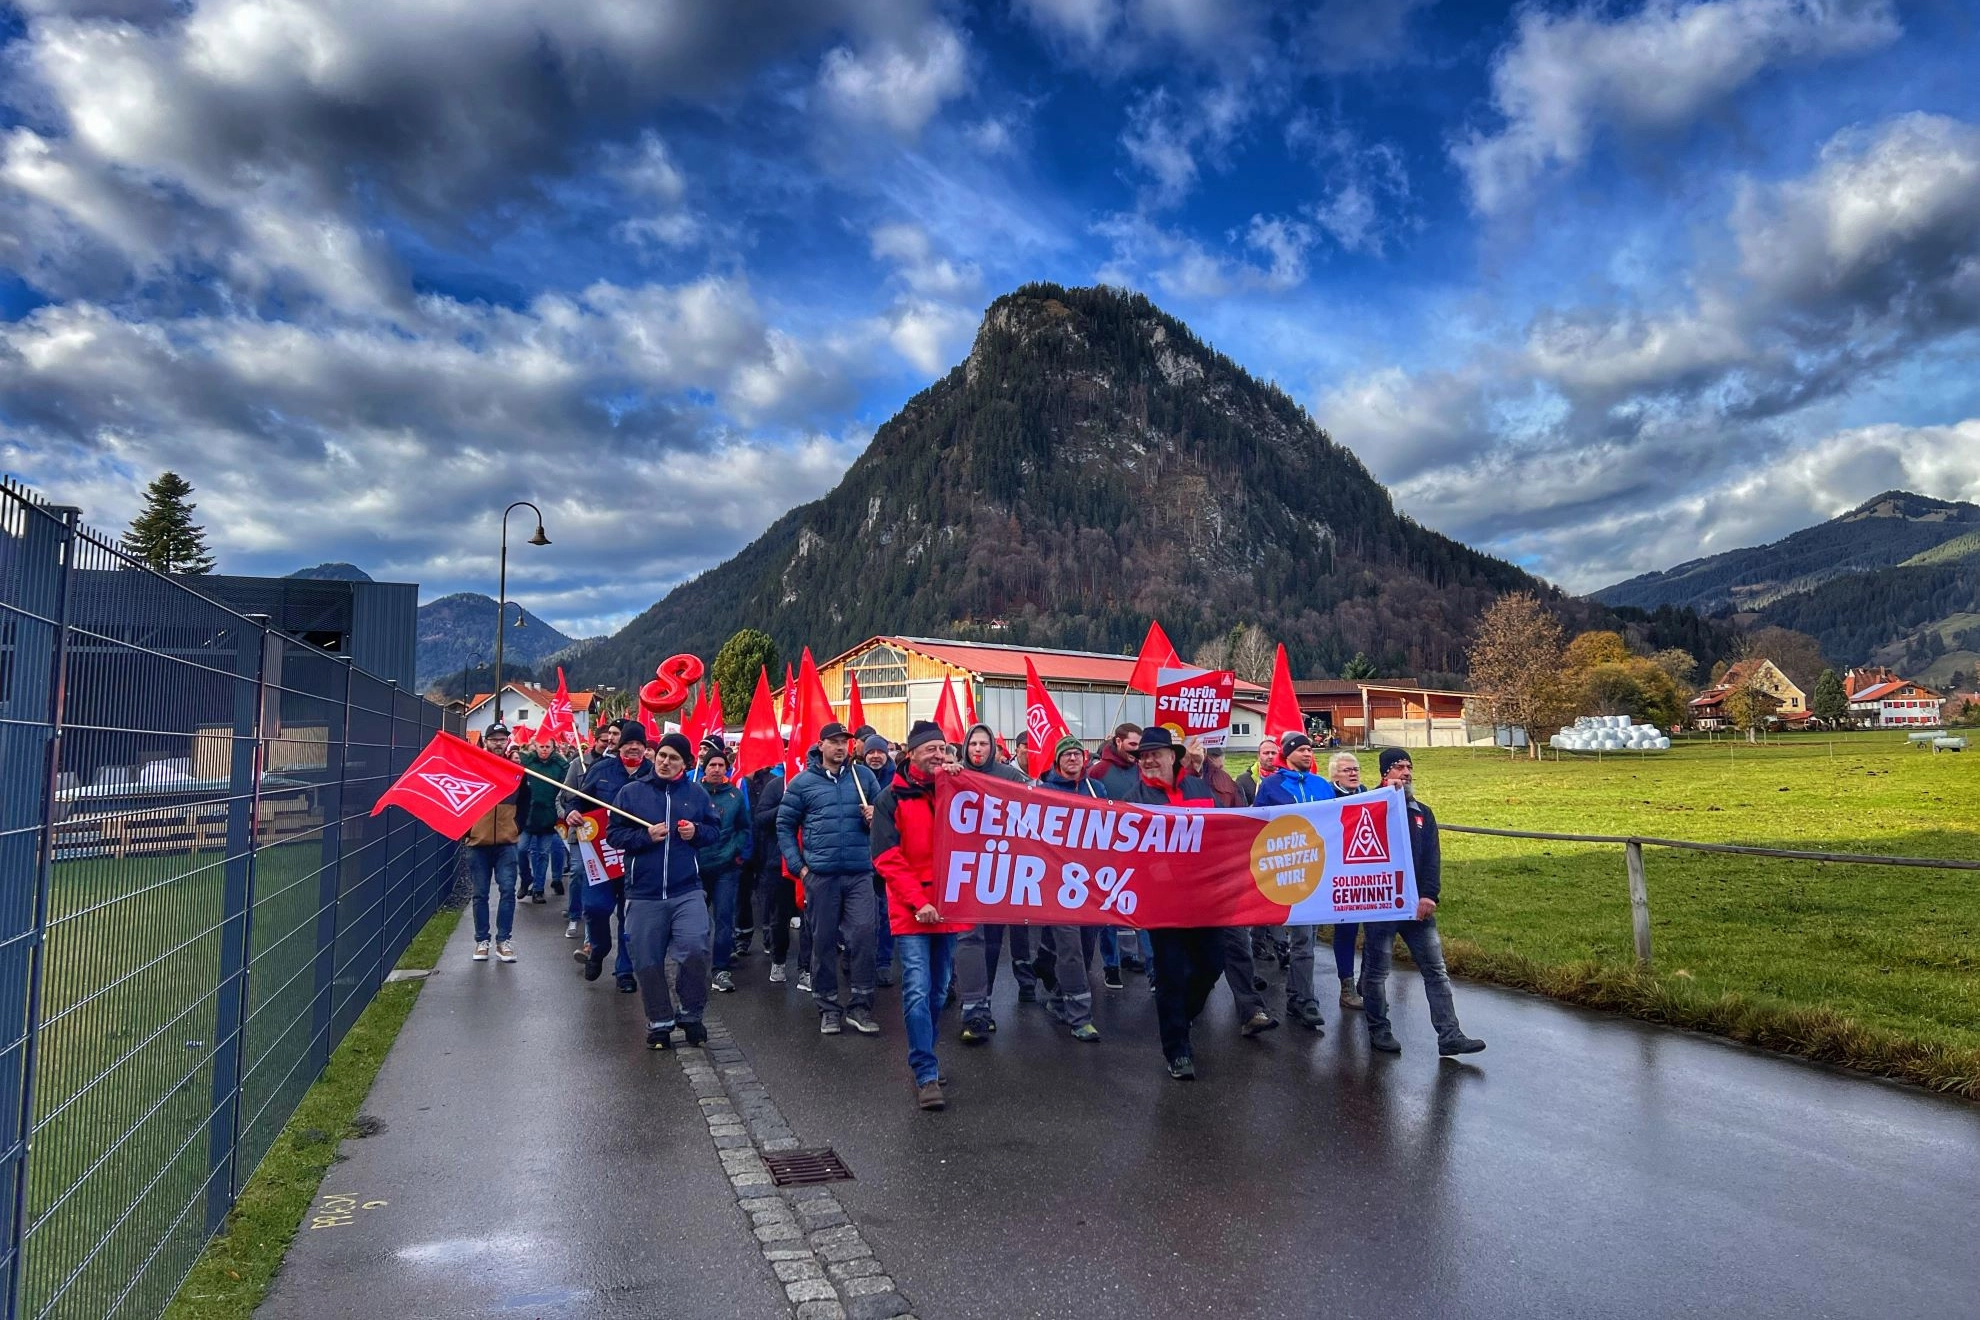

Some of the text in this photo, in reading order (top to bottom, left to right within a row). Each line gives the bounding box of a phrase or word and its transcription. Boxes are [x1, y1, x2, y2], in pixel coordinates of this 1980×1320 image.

[640, 654, 704, 713] 8
[1180, 686, 1217, 698] DAFÜR
[1158, 696, 1231, 713] STREITEN
[1188, 713, 1219, 728] WIR
[949, 791, 1205, 853] GEMEINSAM
[1266, 831, 1308, 853] DAFÜR
[1258, 847, 1319, 872] STREITEN
[944, 839, 1138, 915] FÜR 8%
[1276, 868, 1306, 886] WIR!
[1332, 871, 1393, 887] SOLIDARITÄT
[1333, 904, 1378, 912] TARIFBEWEGUNG
